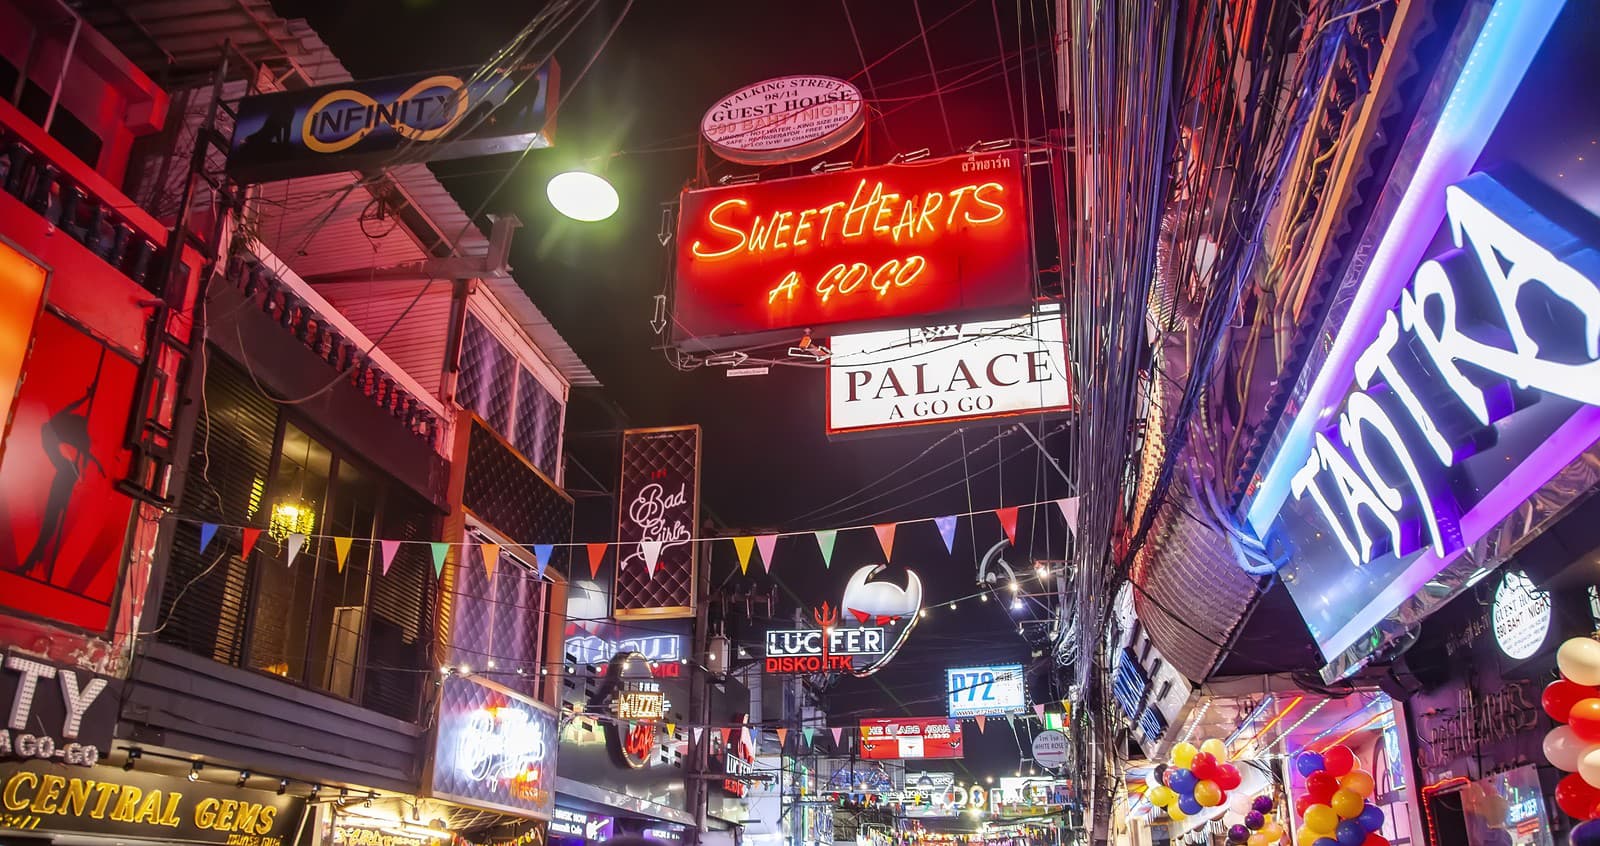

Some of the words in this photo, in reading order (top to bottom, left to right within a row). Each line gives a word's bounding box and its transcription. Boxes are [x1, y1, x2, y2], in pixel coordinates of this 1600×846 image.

[712, 103, 777, 123] GUEST
[785, 90, 853, 111] HOUSE
[720, 82, 785, 109] WALKING
[789, 79, 845, 92] STREET
[764, 89, 798, 101] 98/14
[769, 271, 798, 304] A
[844, 349, 1052, 402] PALACE
[1291, 185, 1600, 568] TANTRA
[889, 404, 904, 420] A
[913, 399, 948, 417] GO
[957, 395, 994, 412] GO
[0, 652, 108, 739] TY
[952, 671, 995, 702] P72
[885, 725, 921, 735] GASS
[924, 724, 961, 734] HOUE
[3, 771, 182, 829] CENTRAL
[195, 797, 277, 835] GEMS
